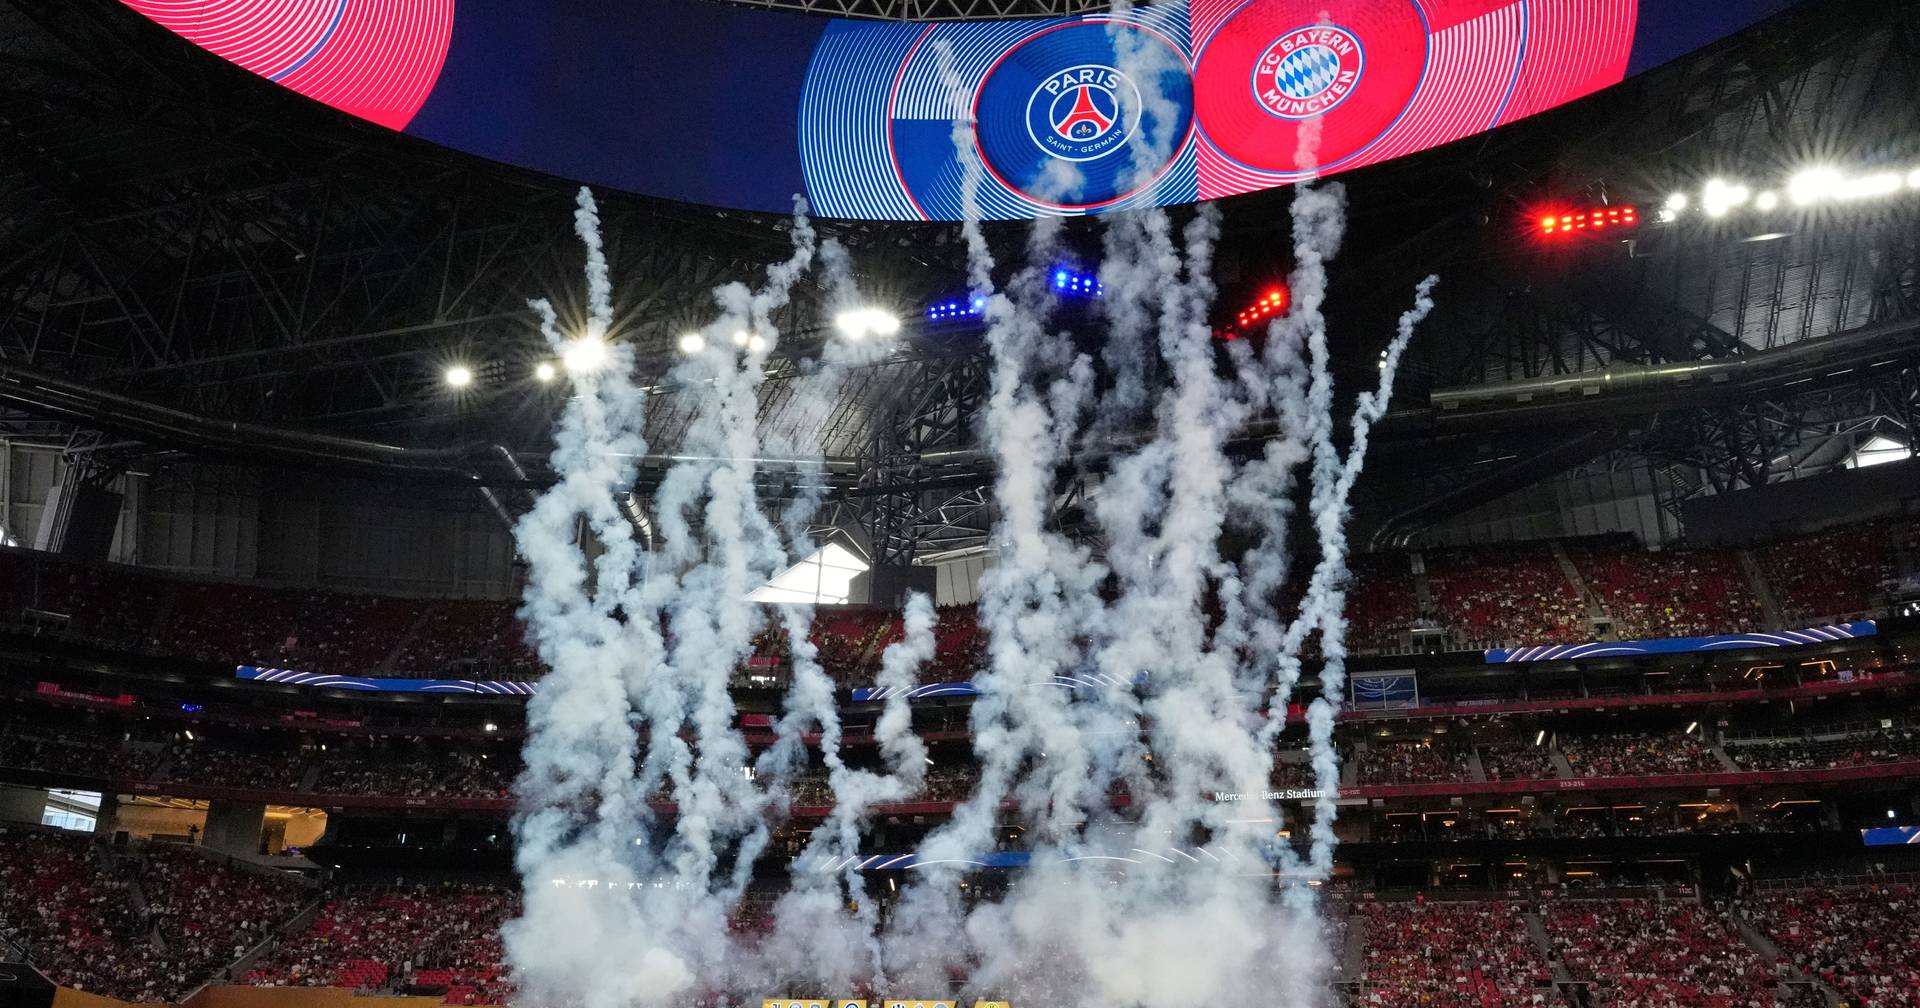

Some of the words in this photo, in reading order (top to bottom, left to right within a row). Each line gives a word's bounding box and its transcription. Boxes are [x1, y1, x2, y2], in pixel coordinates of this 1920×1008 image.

[1260, 53, 1280, 74] FC
[1280, 31, 1354, 56] BAYERN
[1045, 69, 1120, 96] PARIS
[1262, 70, 1355, 113] MÜNCHEN
[1046, 136, 1072, 151] SAINT
[1081, 129, 1122, 153] GERMAIN
[1286, 788, 1326, 799] Stadium
